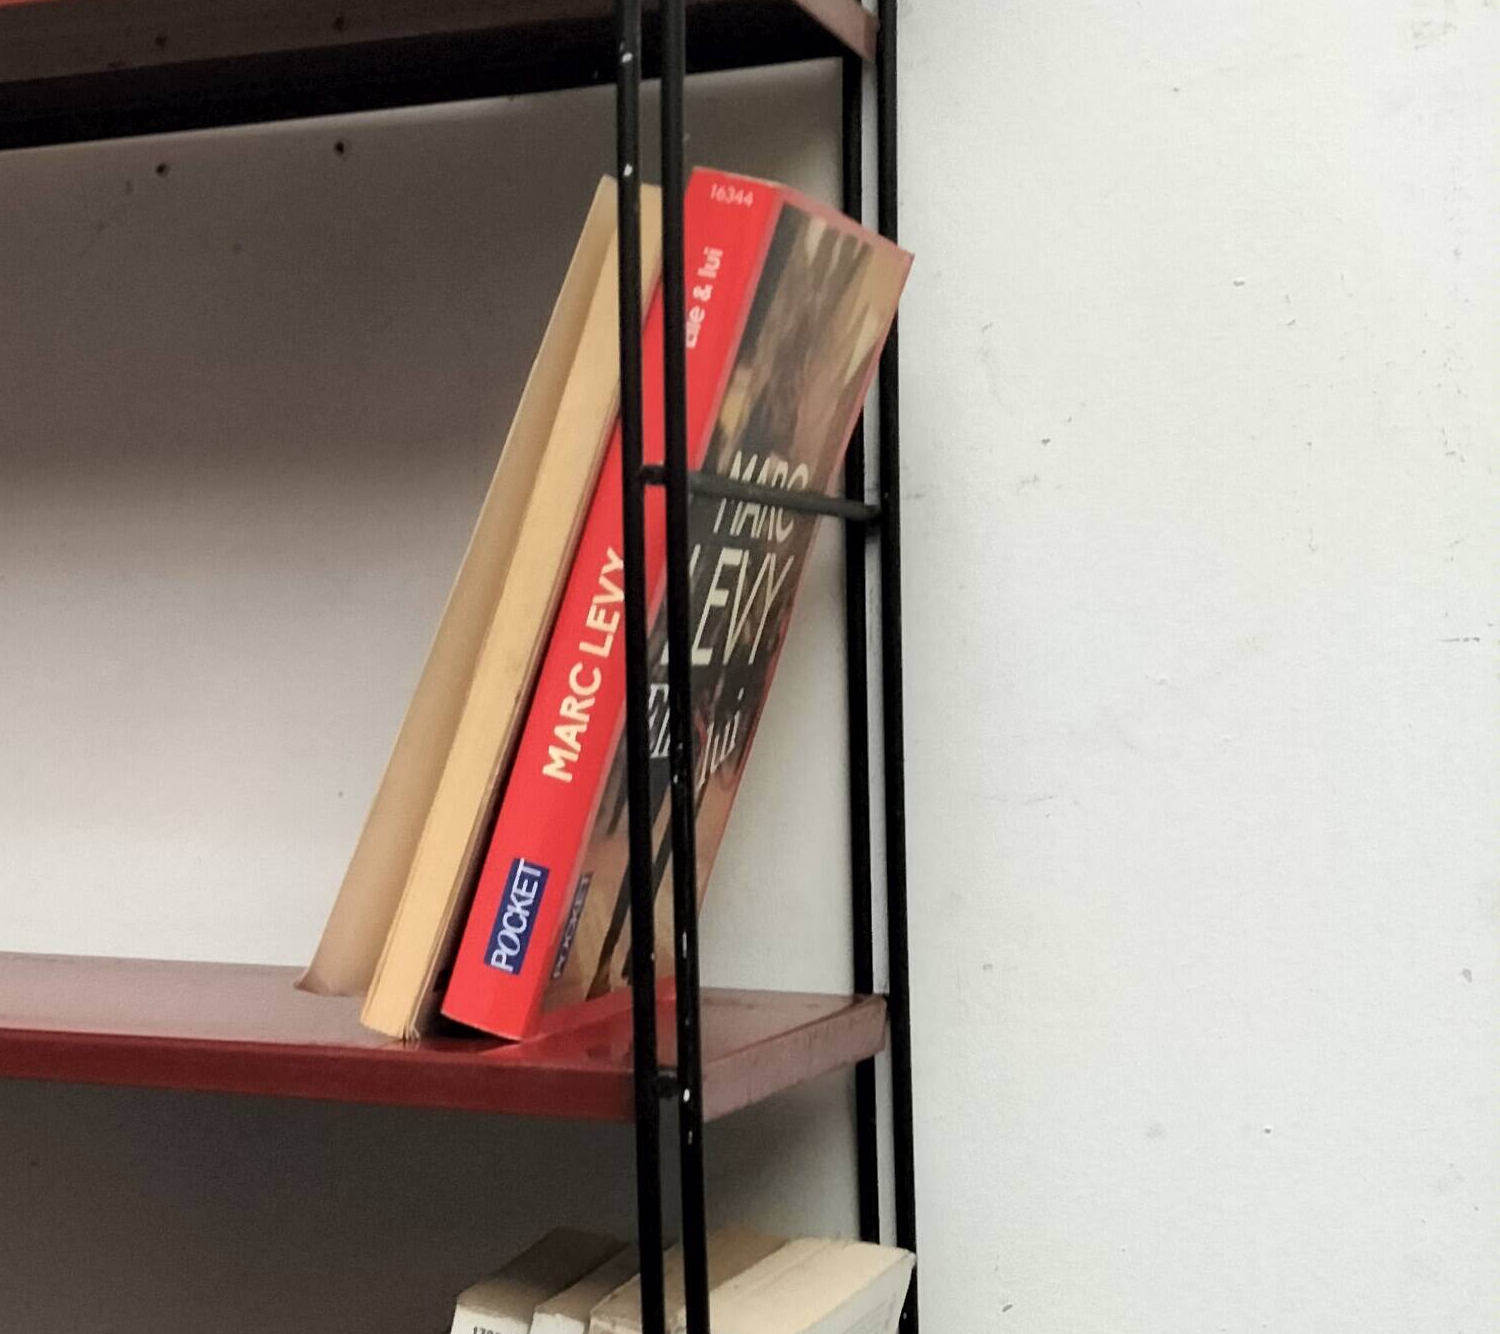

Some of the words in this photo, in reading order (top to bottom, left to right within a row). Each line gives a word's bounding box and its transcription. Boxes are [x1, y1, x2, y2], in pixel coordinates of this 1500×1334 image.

[710, 183, 754, 208] 16344
[697, 246, 724, 279] lui
[713, 450, 809, 543] MARC
[542, 662, 602, 783] MARC
[579, 548, 625, 658] LEVY
[490, 858, 542, 973] POCKET
